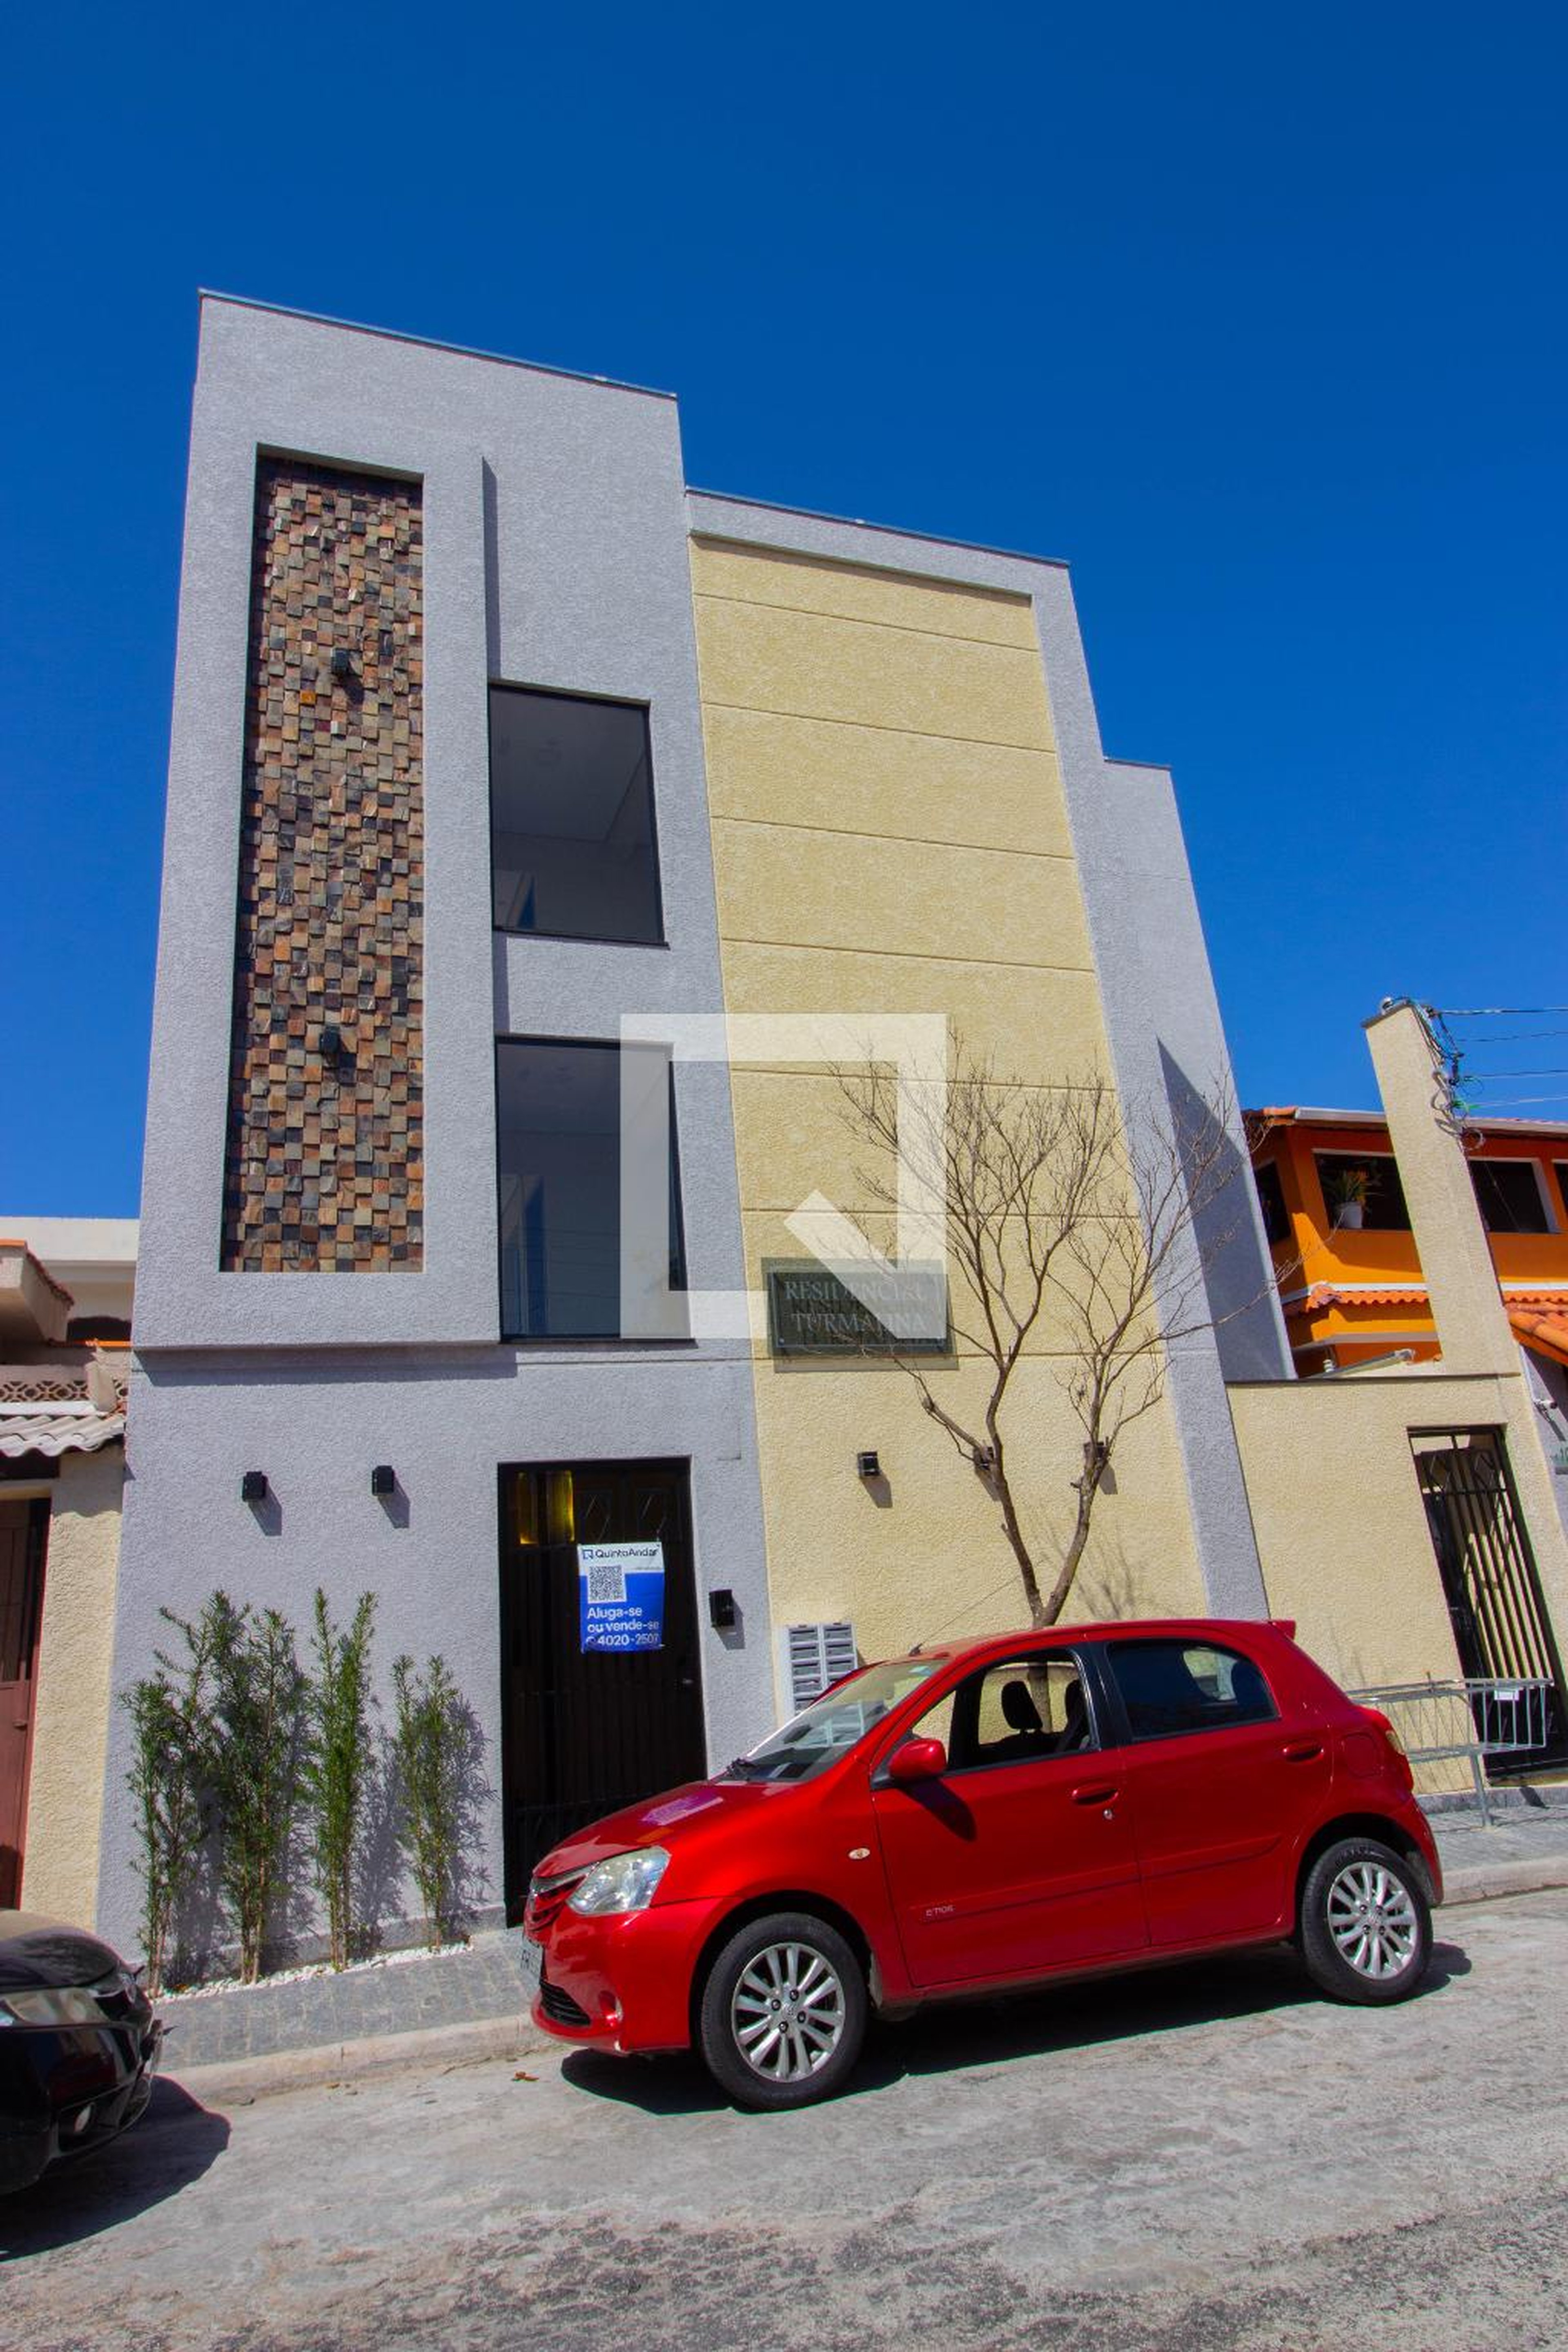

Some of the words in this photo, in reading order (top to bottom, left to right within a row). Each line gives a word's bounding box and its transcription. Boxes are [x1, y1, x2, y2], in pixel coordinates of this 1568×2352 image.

[595, 1548, 657, 1558] QuintoAndar
[587, 1607, 642, 1619] Aluga-se
[587, 1624, 604, 1633] ou
[605, 1618, 659, 1631] vende-se
